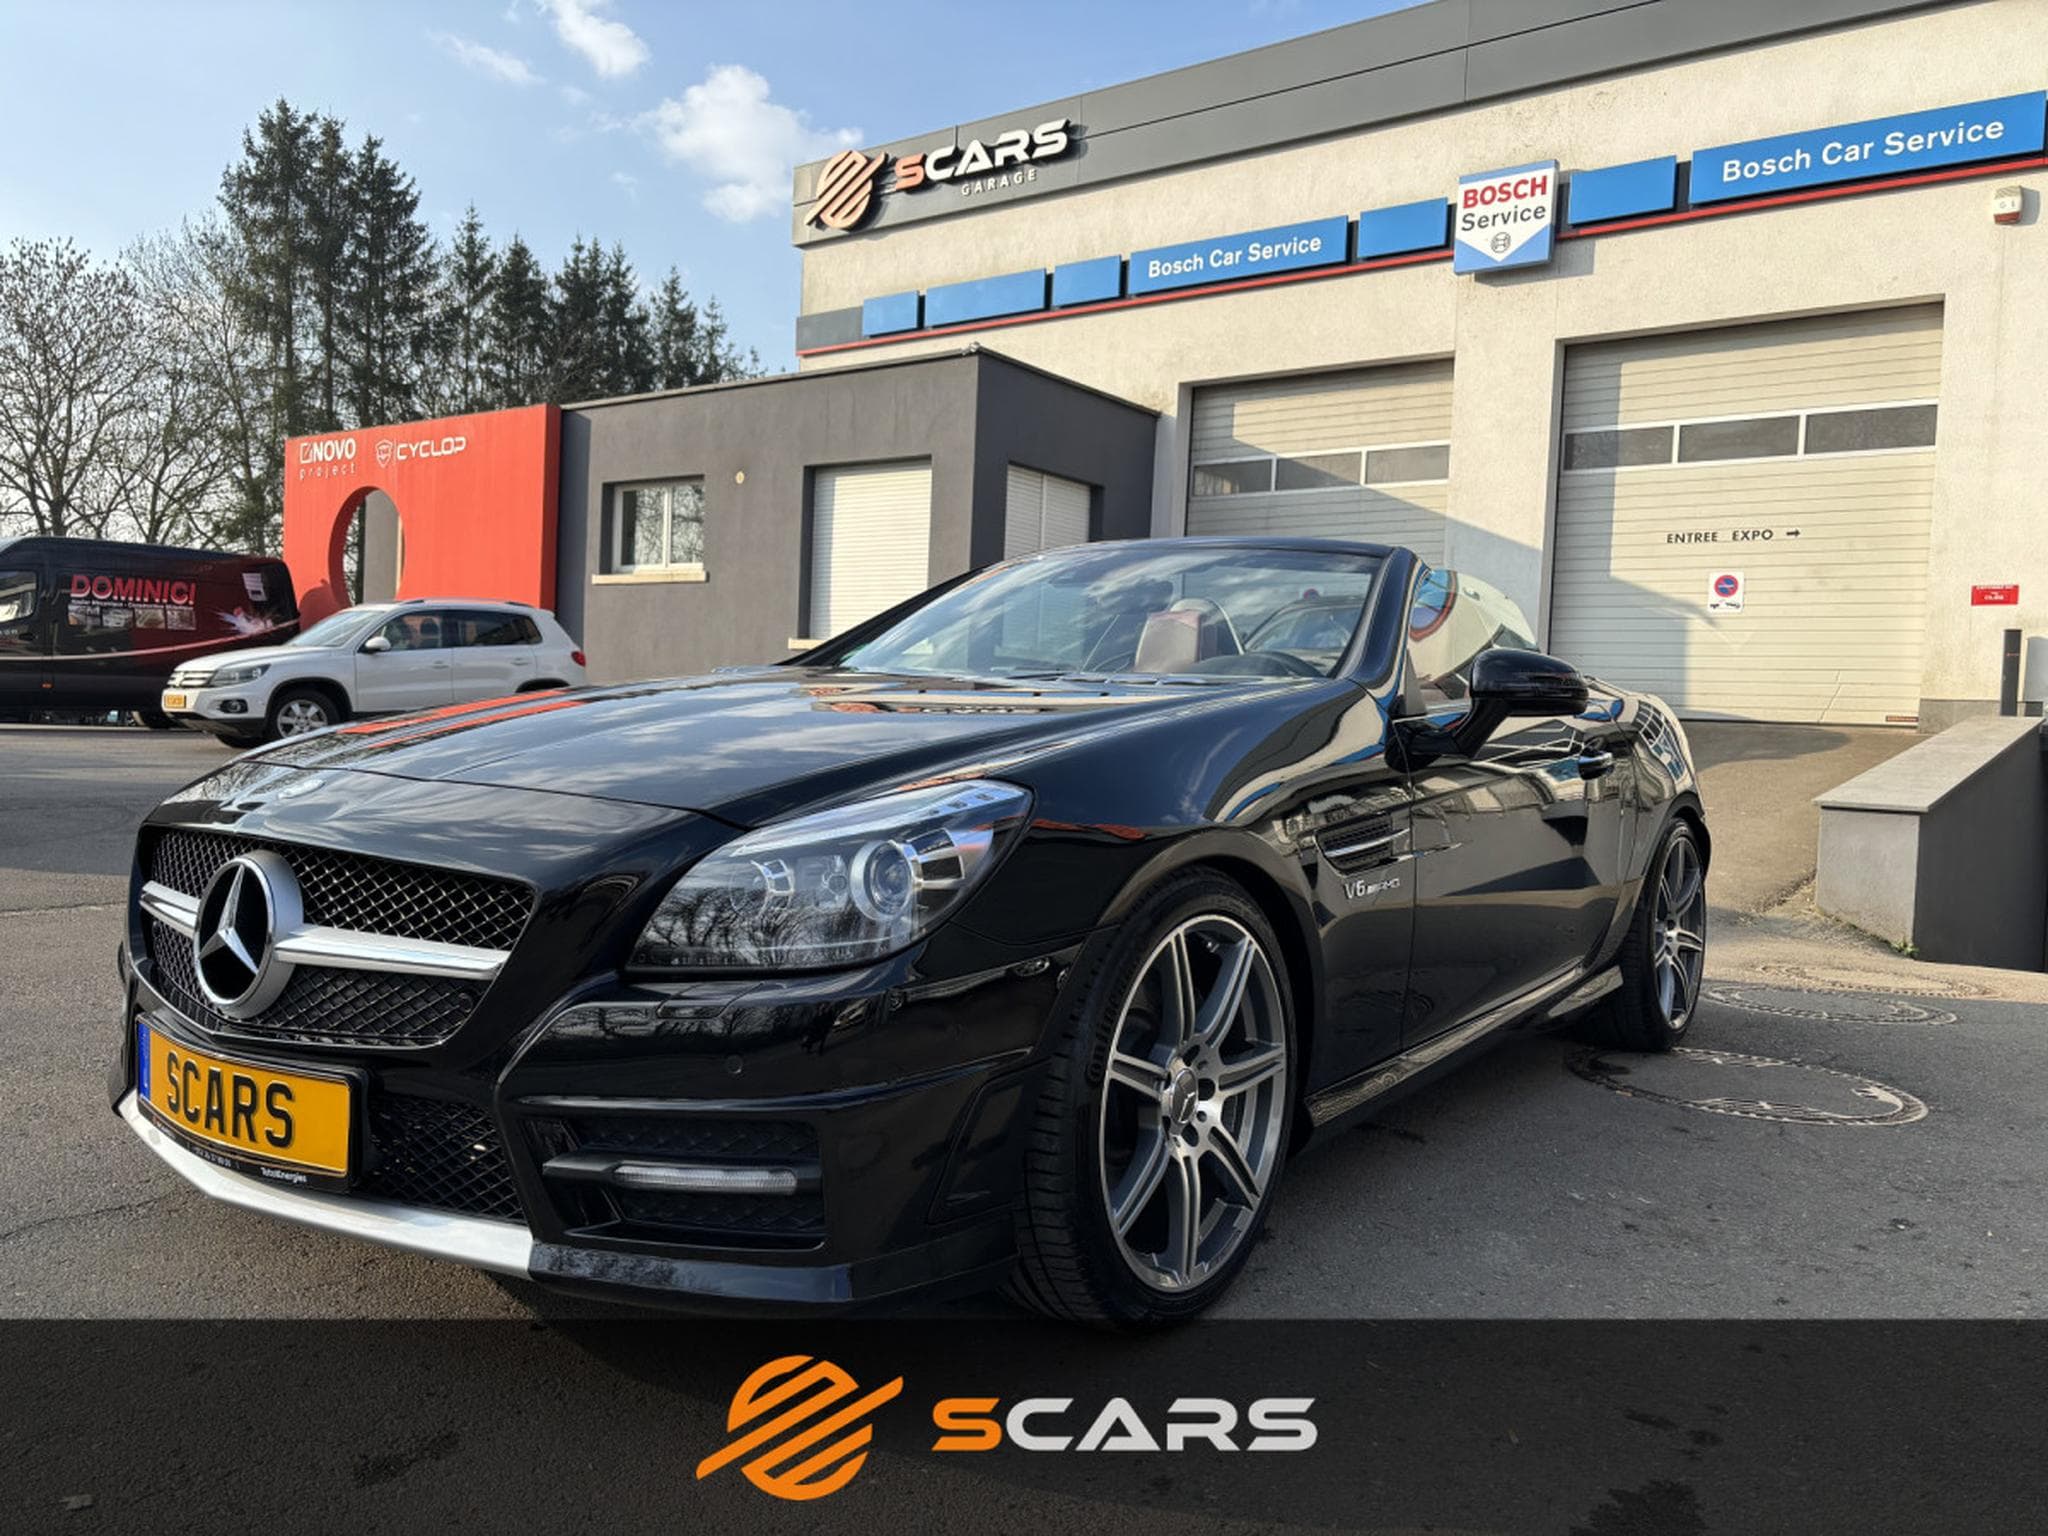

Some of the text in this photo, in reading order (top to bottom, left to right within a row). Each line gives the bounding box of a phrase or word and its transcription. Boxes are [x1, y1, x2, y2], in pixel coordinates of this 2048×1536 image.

[895, 118, 1069, 191] SCARS
[1722, 121, 2004, 183] Bosch Car Service
[962, 169, 1037, 196] GARAGE
[1462, 175, 1547, 209] BOSCH
[1461, 204, 1547, 231] Service
[1148, 236, 1322, 278] Bosch Car Service
[396, 436, 467, 460] CYCLOP
[300, 463, 356, 480] project
[1667, 529, 1774, 544] ENTREE EXPO
[70, 574, 197, 605] DOMINICI
[167, 1051, 294, 1148] SCARS
